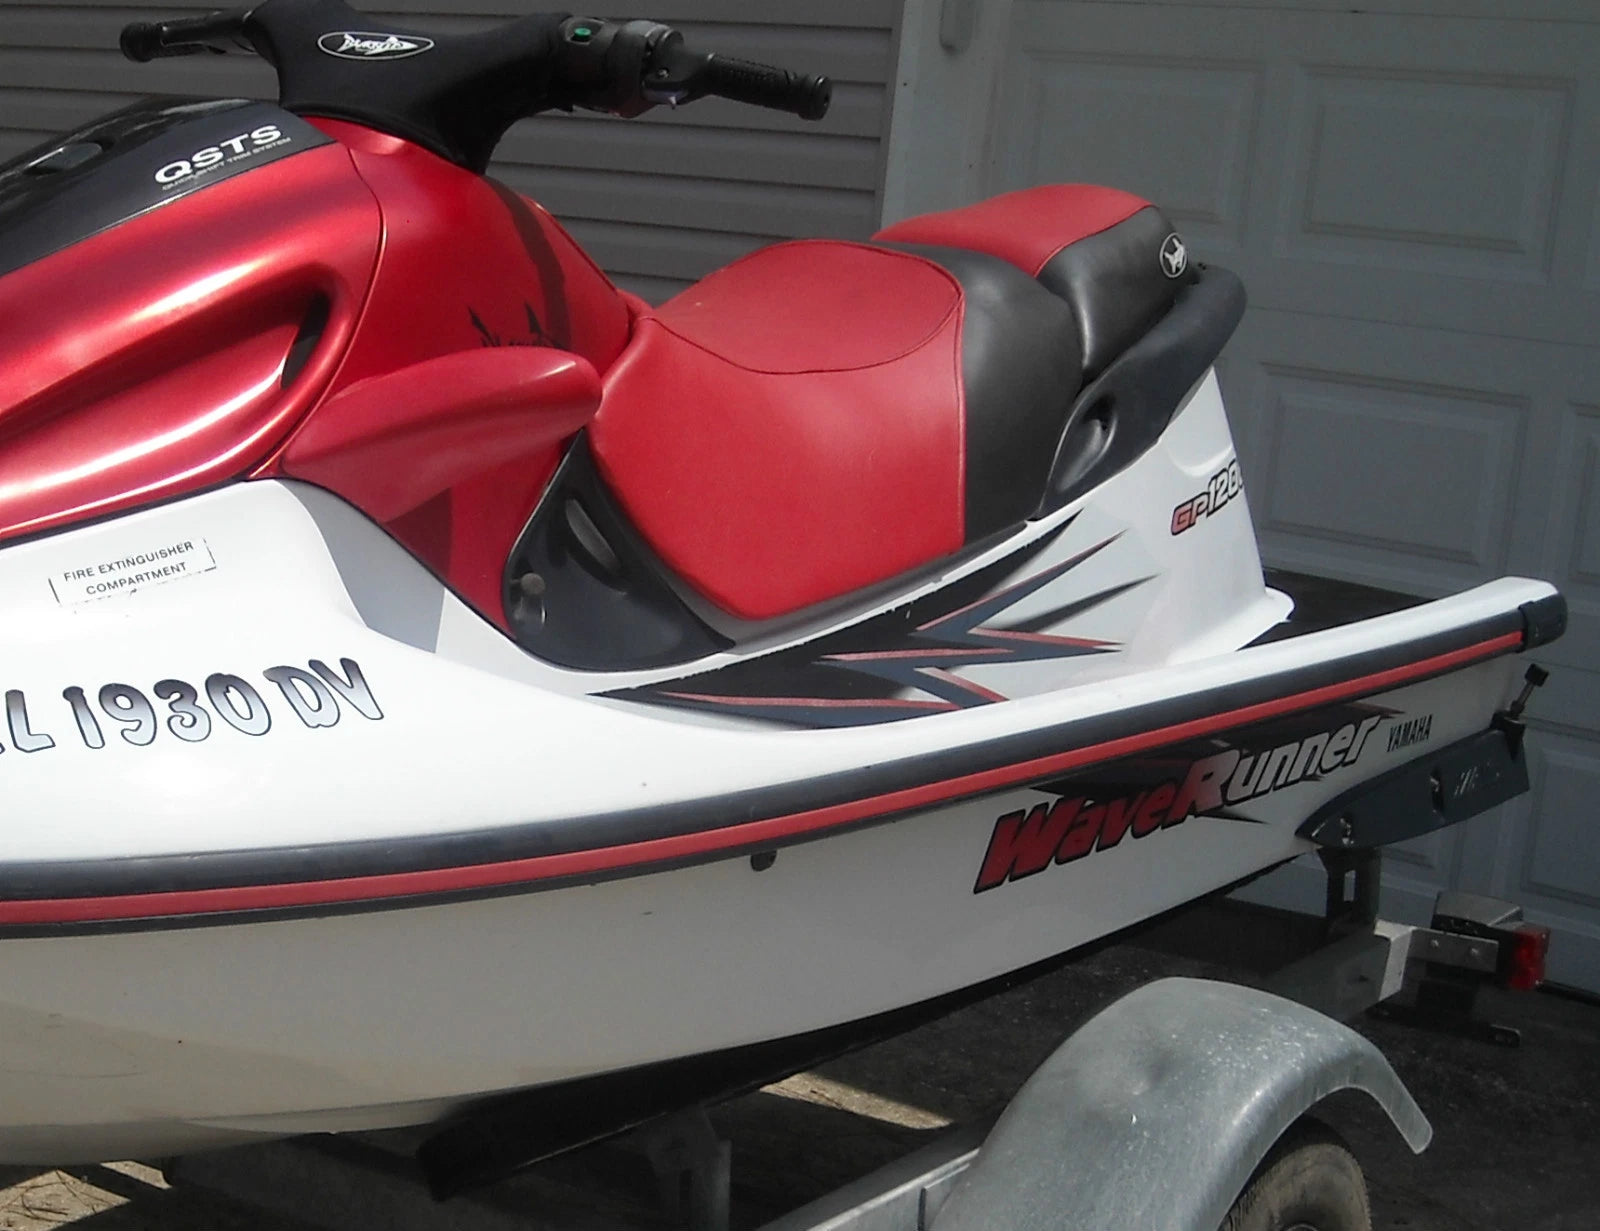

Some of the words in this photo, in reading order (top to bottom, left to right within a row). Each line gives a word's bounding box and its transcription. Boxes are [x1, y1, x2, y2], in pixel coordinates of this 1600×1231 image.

[155, 125, 282, 184] QSTS
[63, 567, 95, 582] FIRE
[98, 541, 194, 574] EXTINGUISHER
[86, 561, 187, 595] COMPARTMENT
[0, 689, 56, 754] L
[62, 672, 272, 749] 1930
[262, 657, 384, 728] DV
[1387, 714, 1433, 752] YAMAHA
[973, 715, 1386, 894] WaveRunner
